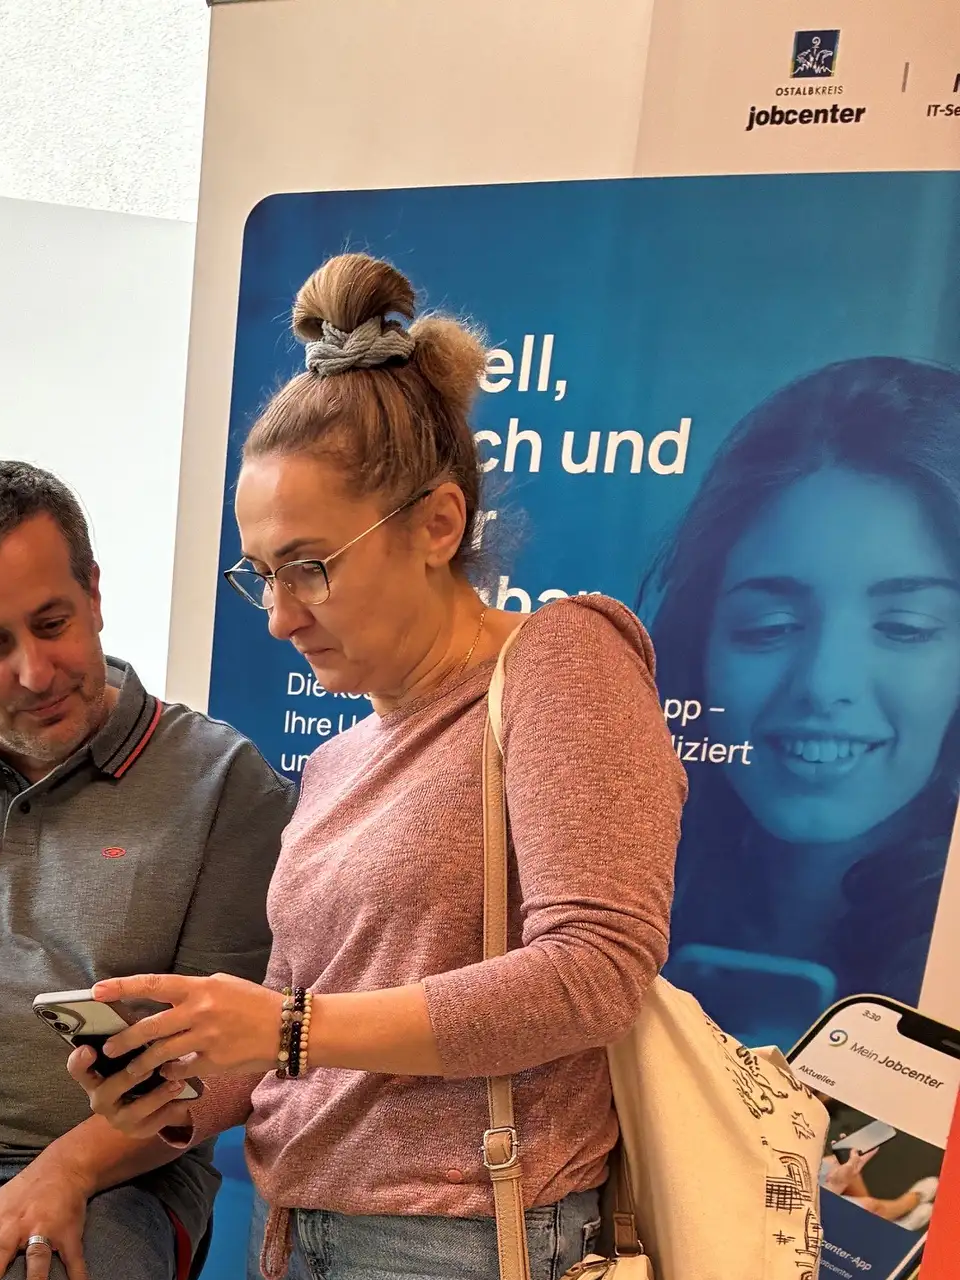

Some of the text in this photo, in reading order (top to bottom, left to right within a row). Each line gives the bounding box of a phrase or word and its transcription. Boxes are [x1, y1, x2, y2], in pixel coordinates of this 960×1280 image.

[775, 85, 844, 97] OSTALBKREIS
[745, 104, 866, 131] jobcenter
[927, 103, 960, 117] IT-Se
[479, 334, 568, 401] ell,
[474, 418, 692, 475] ch und
[287, 672, 327, 698] Die
[664, 698, 702, 727] pp
[284, 710, 332, 736] Ihre
[671, 734, 754, 765] liziert
[862, 1010, 882, 1022] 3:30
[798, 1065, 836, 1087] Aktuelles
[850, 1042, 944, 1089] Mein Jobcenter
[820, 1239, 872, 1271] center-App
